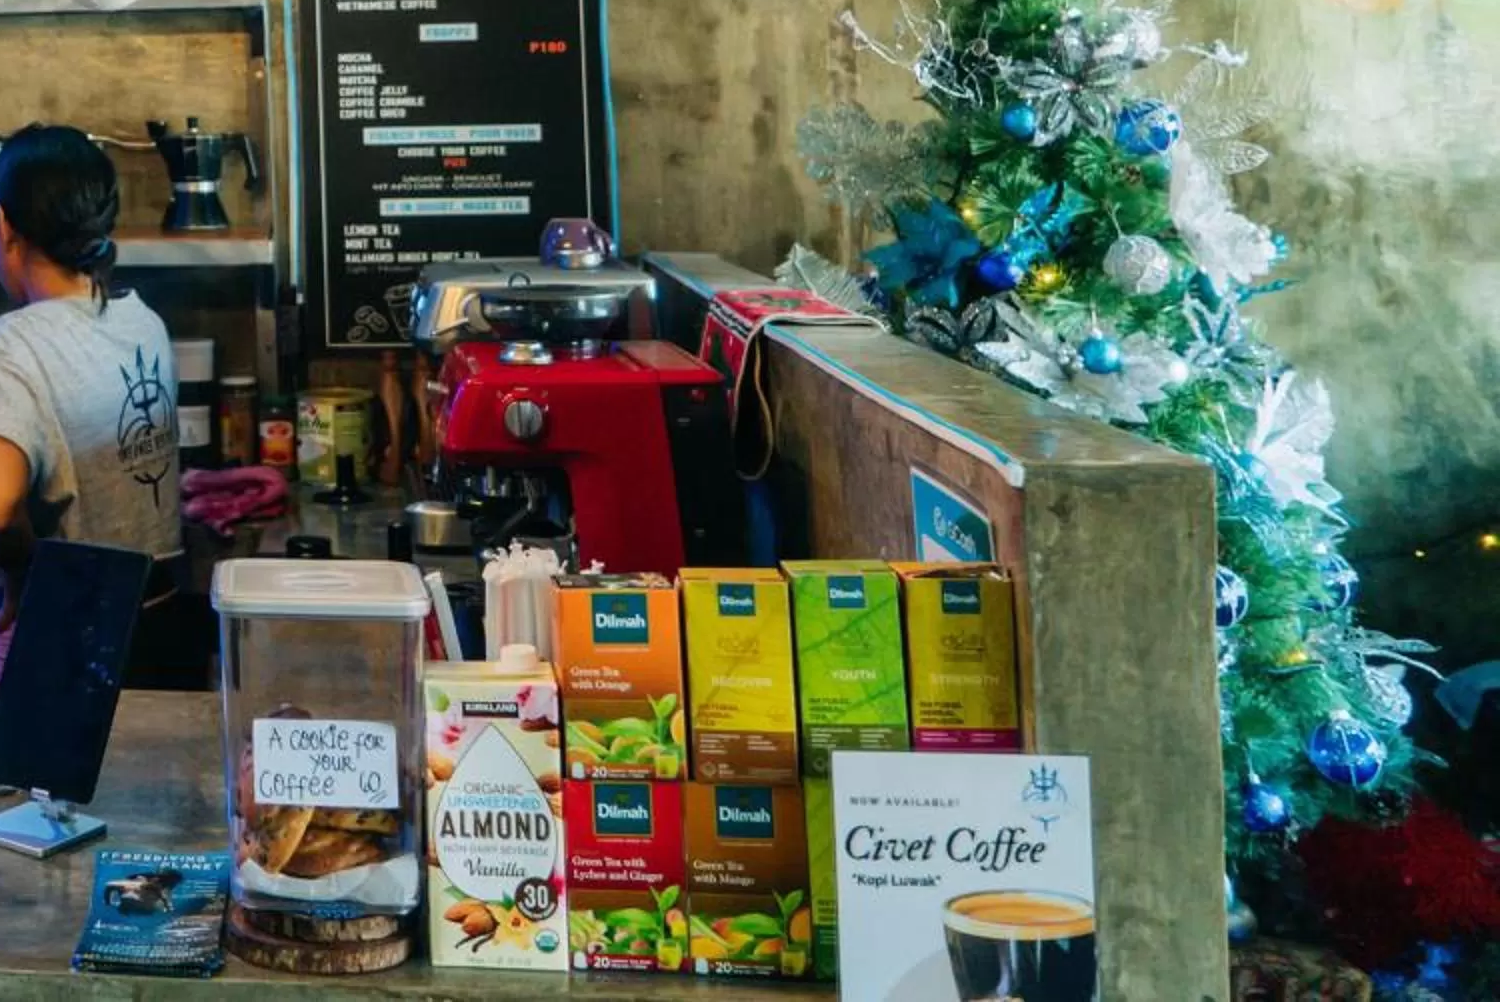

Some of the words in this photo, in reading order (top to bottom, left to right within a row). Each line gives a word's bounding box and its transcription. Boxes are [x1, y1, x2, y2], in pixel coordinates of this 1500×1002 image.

[400, 0, 437, 10] COFFEE
[339, 86, 375, 97] COFFEE
[380, 85, 408, 96] JELLY
[339, 98, 376, 108] COFFEE
[339, 109, 376, 119] COFFEE
[469, 145, 508, 156] COFFEE
[344, 224, 378, 236] LEMON
[382, 223, 400, 235] TEA
[374, 237, 393, 249] TEA
[829, 588, 863, 599] Dilmah
[719, 596, 753, 607] Dilmah
[595, 613, 646, 629] Dilmah
[570, 666, 601, 677] Green
[831, 669, 876, 680] YOUTH
[571, 680, 594, 690] with
[595, 680, 632, 692] Orange
[465, 702, 517, 712] KIRKLAND
[269, 726, 283, 751] A
[591, 766, 607, 778] 20
[463, 782, 524, 795] ORGANIC
[447, 794, 541, 810] UNSWEETENED
[850, 797, 880, 807] NOW
[885, 797, 960, 808] AVAILABLE!
[597, 803, 649, 820] Dilmah
[718, 806, 771, 823] Dilmah
[440, 810, 551, 841] ALMOND
[845, 824, 937, 862] Civet
[946, 827, 1048, 873] Coffee
[160, 861, 223, 871] PLANET
[572, 855, 603, 867] Green
[604, 856, 622, 867] Tea
[624, 856, 647, 868] with
[693, 859, 725, 871] Green
[726, 860, 744, 871] Tea
[463, 858, 526, 878] Vanilla
[609, 870, 628, 880] and
[629, 870, 664, 883] Ginger
[694, 873, 717, 884] with
[719, 875, 755, 887] Mango
[523, 884, 549, 909] 30
[592, 956, 610, 968] 20
[716, 961, 733, 973] 20
